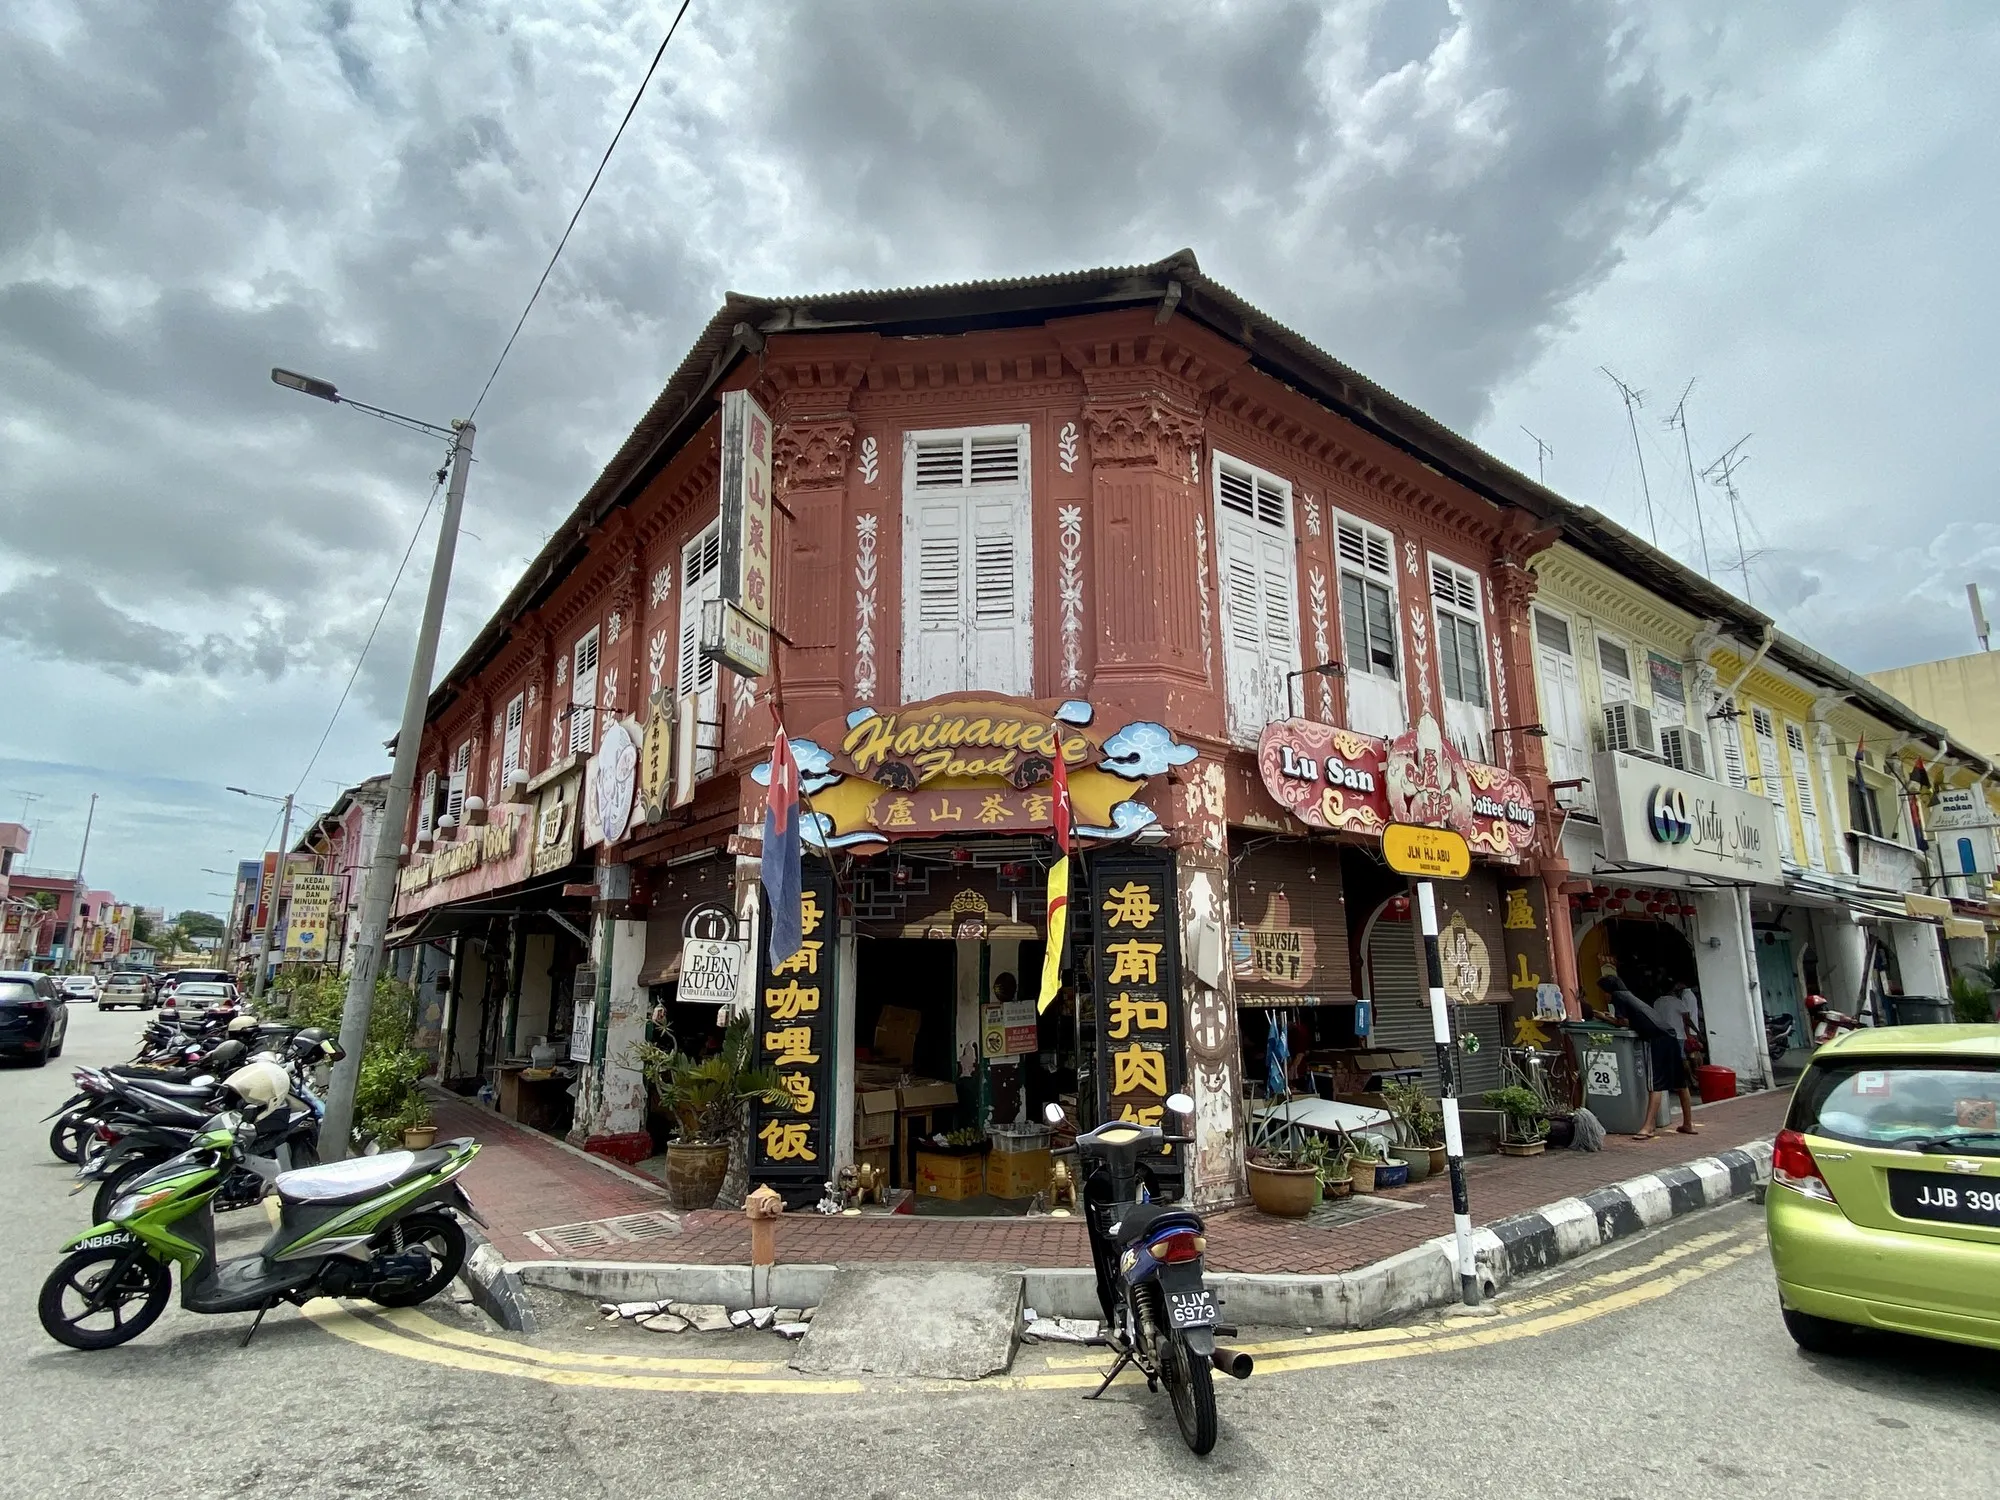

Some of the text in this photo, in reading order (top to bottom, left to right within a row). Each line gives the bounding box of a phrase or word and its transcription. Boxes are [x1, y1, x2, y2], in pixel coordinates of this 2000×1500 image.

[843, 713, 1088, 772] Hainanese
[915, 750, 1016, 782] Food
[1281, 746, 1318, 780] Lu
[1326, 756, 1375, 793] San
[1942, 793, 1969, 803] kedai
[1942, 803, 1973, 812] makan
[1508, 803, 1535, 827] Shop
[1691, 798, 1761, 862] Sixty Nine
[1407, 845, 1450, 863] JLN HJ. ABU
[261, 872, 274, 909] JOVEN
[294, 898, 327, 906] MINUMAN
[1255, 931, 1300, 952] MALAYSIA
[692, 955, 733, 974] EJEN
[1255, 949, 1300, 981] BEST
[682, 970, 738, 991] KUPON
[1594, 1072, 1610, 1084] 28
[1857, 1071, 1884, 1093] P
[1917, 1186, 1957, 1207] JJB
[1177, 1293, 1205, 1308] JJV
[1173, 1305, 1215, 1321] 6973
